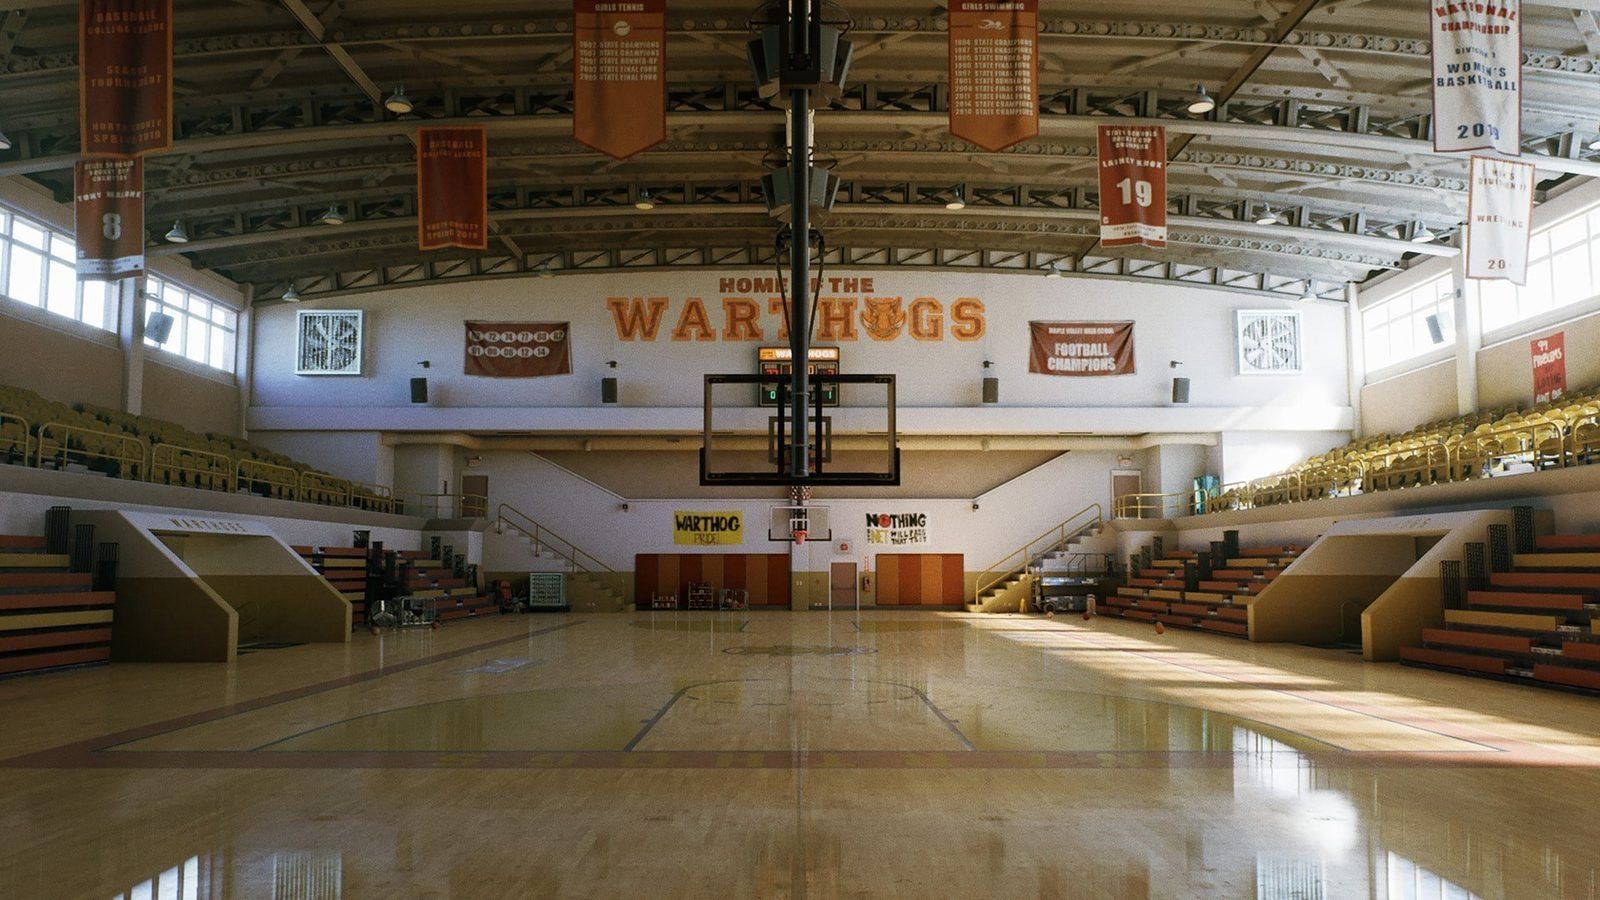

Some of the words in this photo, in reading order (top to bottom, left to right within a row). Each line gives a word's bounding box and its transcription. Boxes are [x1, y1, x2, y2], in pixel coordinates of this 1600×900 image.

[594, 3, 616, 11] GIRLS
[618, 3, 644, 11] TENNIS
[1436, 2, 1516, 20] NATIONAL
[1441, 21, 1510, 34] CHAMPIONSHIP
[974, 46, 993, 54] STATE
[1447, 62, 1506, 77] WOMEN'S
[1437, 75, 1516, 91] BASKETBALL
[975, 108, 994, 116] STATE
[1116, 178, 1152, 207] 19
[103, 213, 121, 240] 8
[719, 277, 788, 293] HOME
[827, 277, 875, 293] THE
[1055, 343, 1109, 357] FOOTBALL
[1047, 357, 1116, 371] CHAMPIONS
[770, 390, 776, 399] 0
[675, 515, 740, 531] WARTHOG
[866, 512, 927, 529] NOTHING
